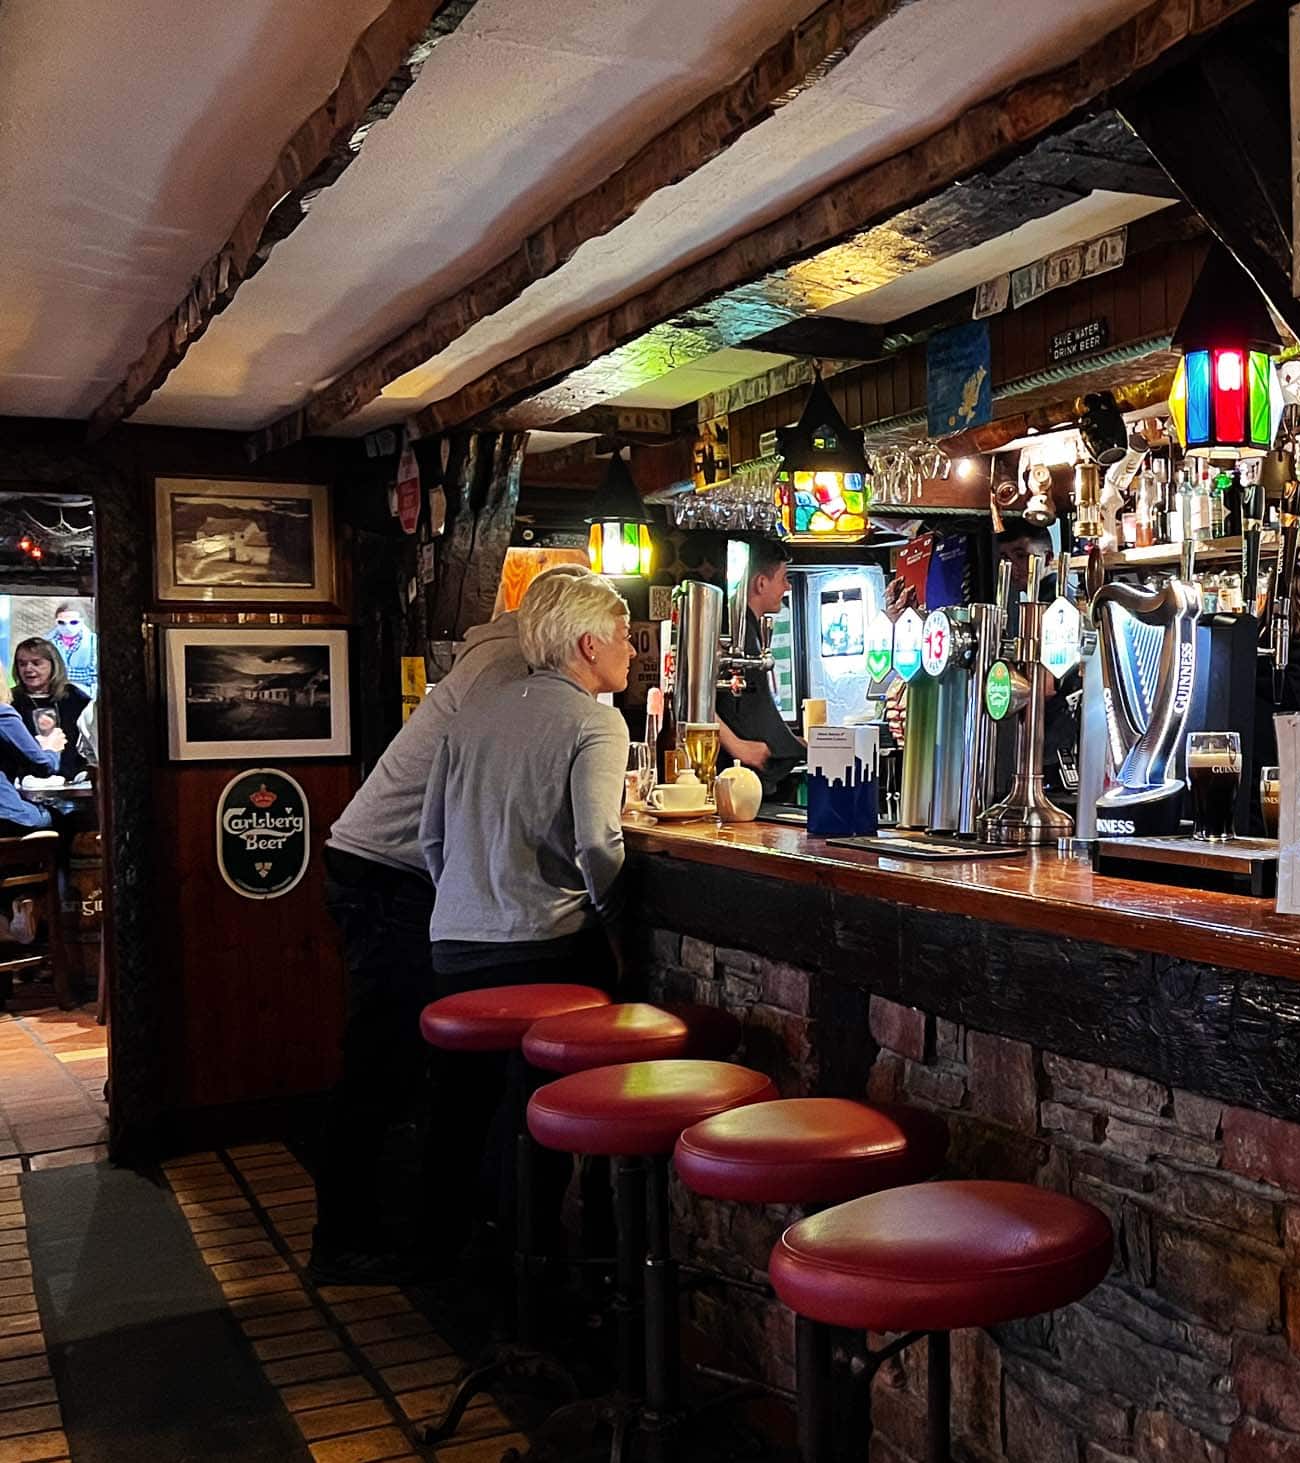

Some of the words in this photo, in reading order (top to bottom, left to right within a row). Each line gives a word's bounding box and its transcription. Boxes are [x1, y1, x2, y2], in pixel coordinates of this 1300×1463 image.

[1053, 343, 1078, 360] DRINK
[1079, 335, 1101, 351] BEER
[1054, 332, 1073, 348] SAVE
[1074, 323, 1099, 340] WATER
[1174, 642, 1193, 713] GUINNESS
[223, 807, 304, 834] Carlsberg
[245, 834, 287, 850] Beer
